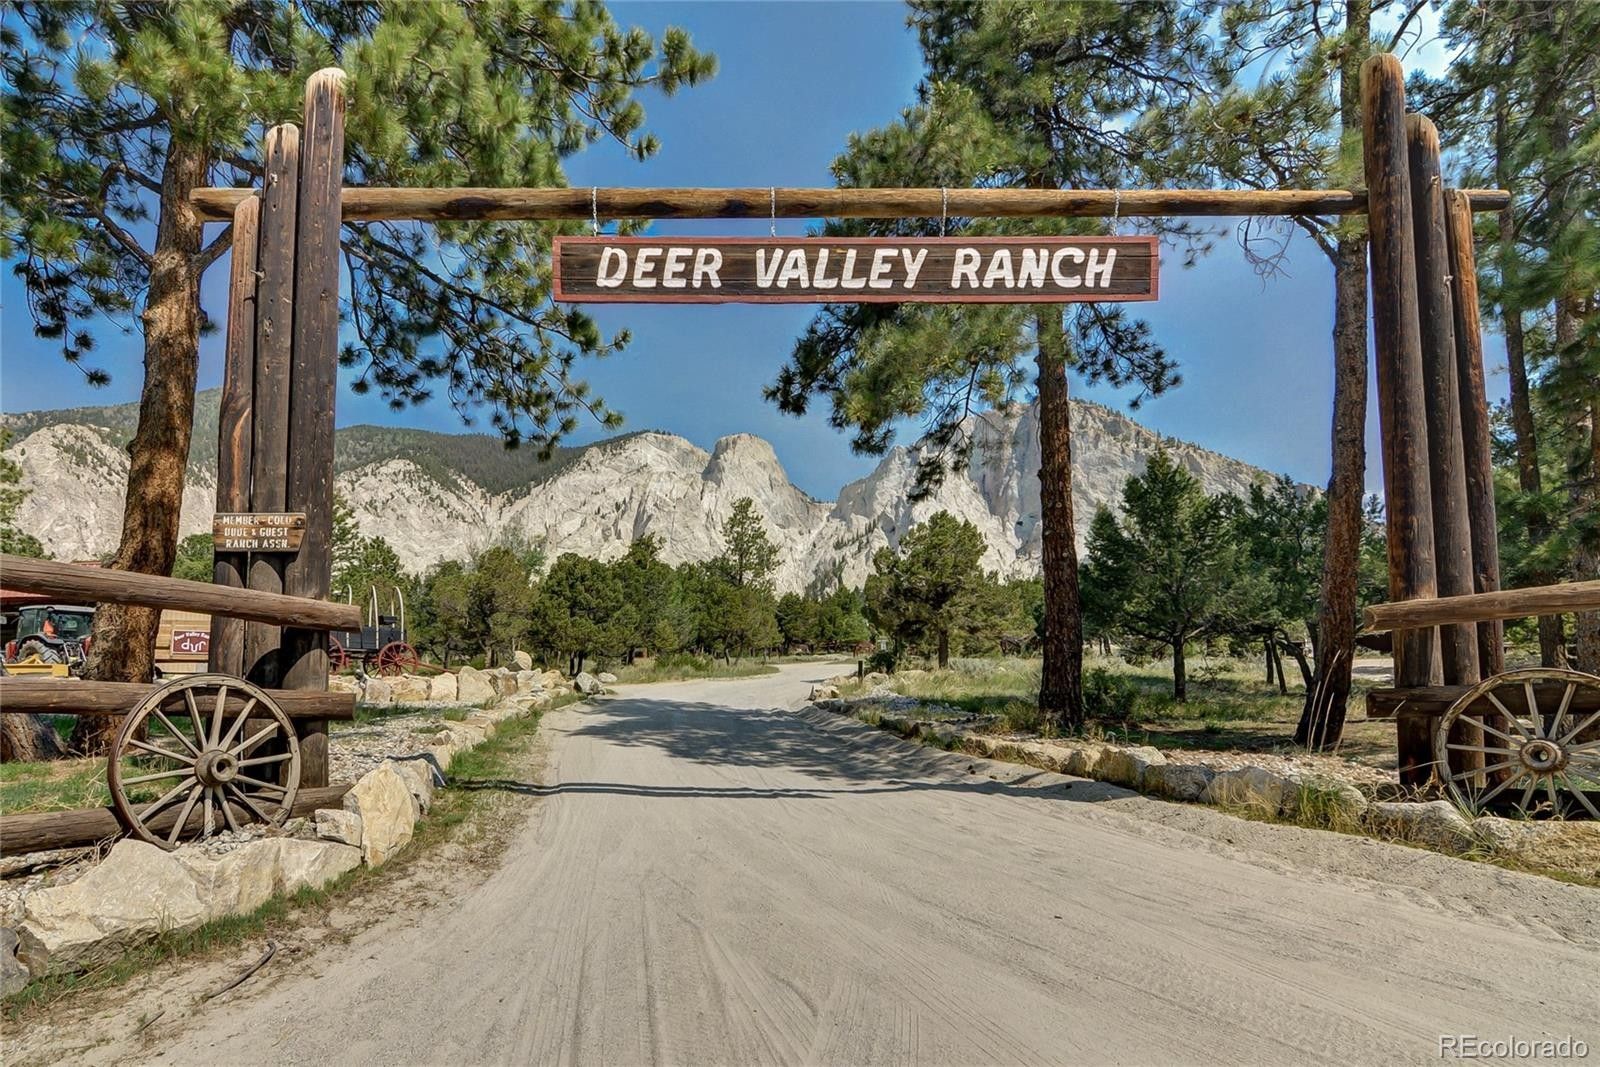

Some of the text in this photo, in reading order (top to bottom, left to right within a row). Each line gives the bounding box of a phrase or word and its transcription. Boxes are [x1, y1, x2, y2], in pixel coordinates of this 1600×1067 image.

[596, 246, 1118, 289] DEER VALLEY RANCH
[223, 516, 259, 525] MEMBER
[224, 528, 289, 537] DUDE & GUEST
[225, 539, 258, 548] RANCH
